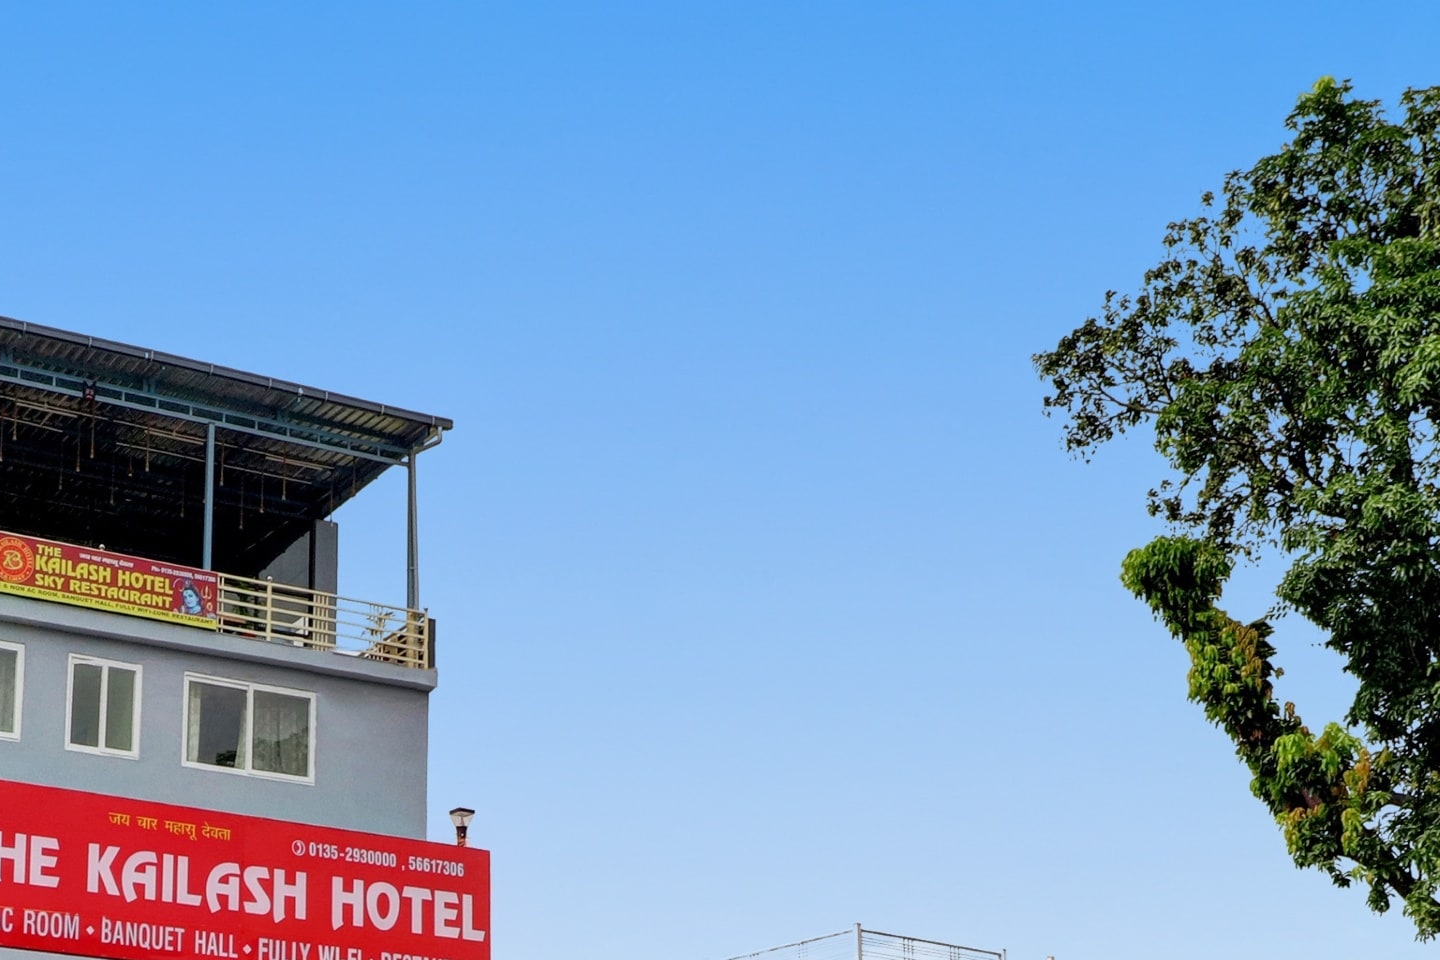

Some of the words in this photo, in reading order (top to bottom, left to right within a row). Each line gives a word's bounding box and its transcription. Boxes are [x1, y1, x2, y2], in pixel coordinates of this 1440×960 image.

[35, 543, 62, 558] THE
[34, 572, 65, 591] SKY
[69, 578, 173, 609] RESTAURANT
[35, 554, 112, 583] KAILASH
[117, 569, 174, 596] HOTEL
[108, 811, 131, 827] जय
[136, 816, 158, 831] चार
[164, 820, 198, 841] महासू
[201, 821, 231, 841] देवता
[308, 841, 397, 868] 0135-2930000
[407, 855, 465, 878] 56617306
[86, 842, 307, 924] KAILASH
[331, 876, 486, 943] HOTEL
[23, 909, 80, 940] ROOM
[101, 915, 185, 952] BANQUET
[194, 928, 238, 959] HALL
